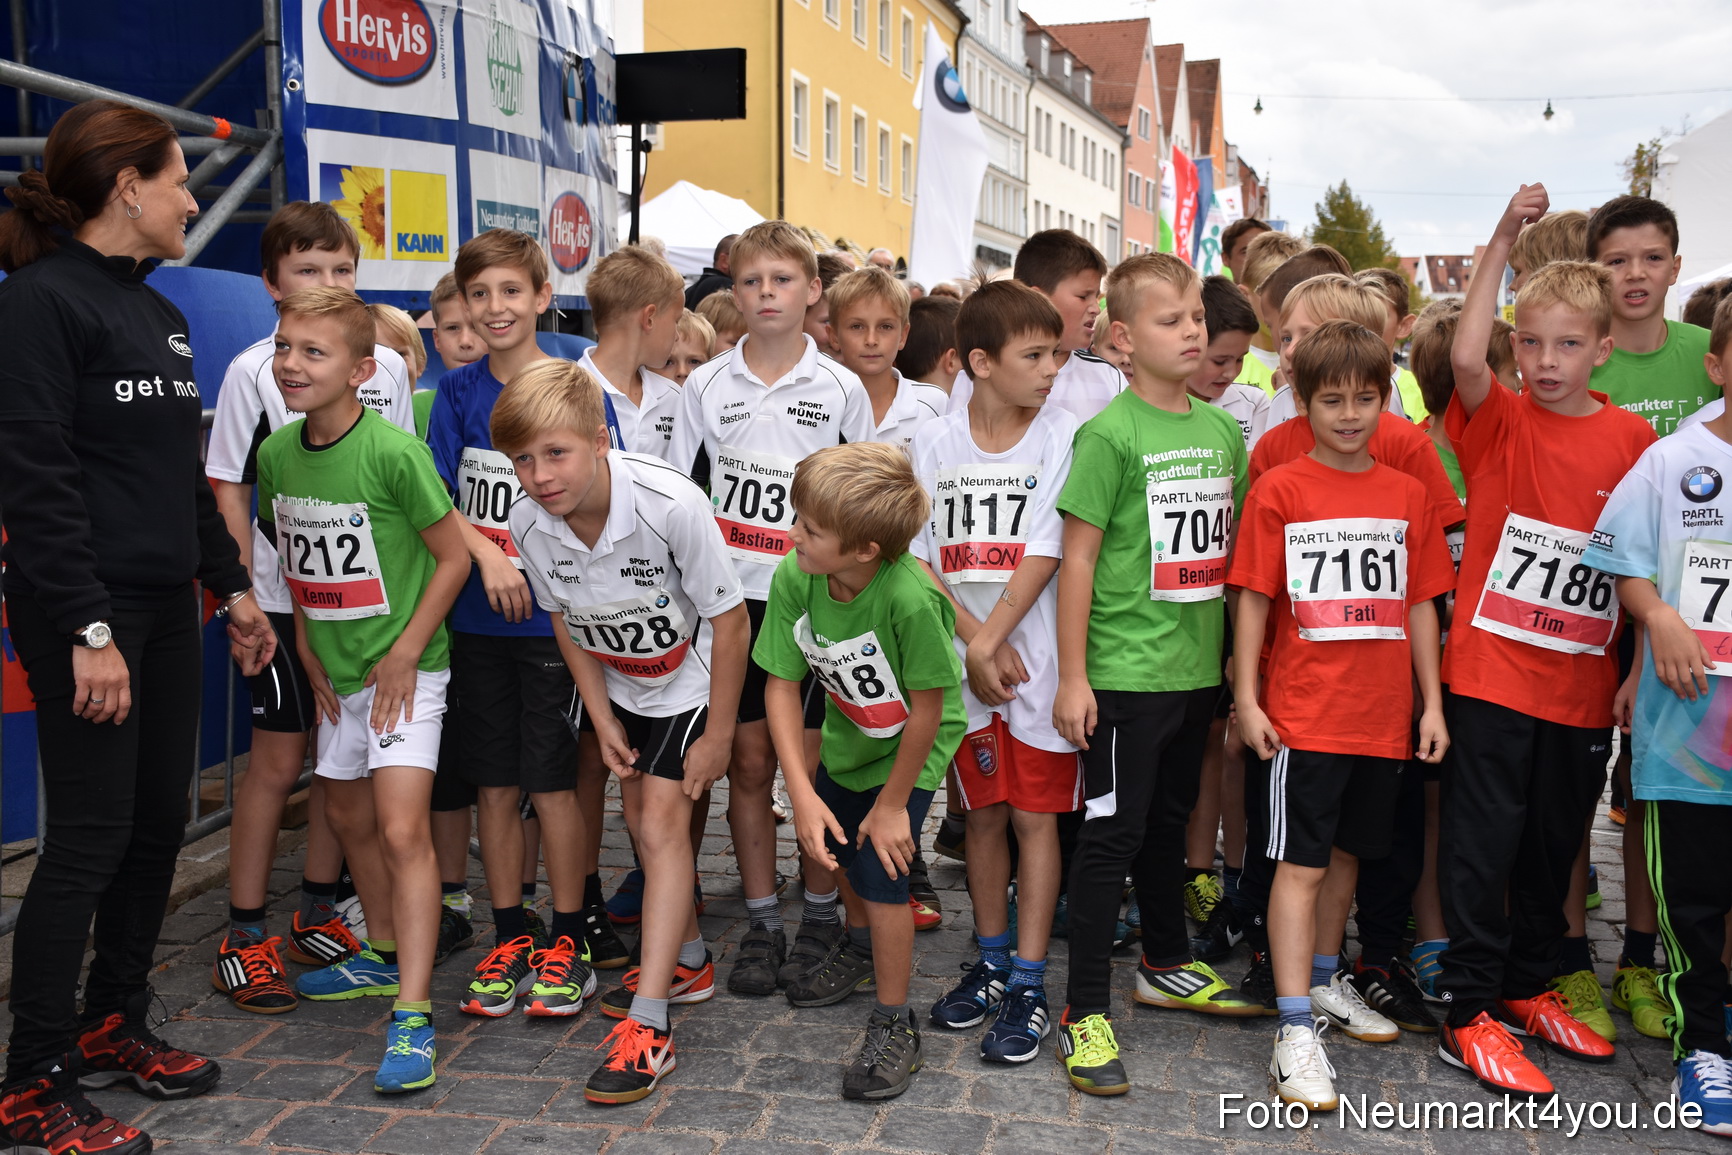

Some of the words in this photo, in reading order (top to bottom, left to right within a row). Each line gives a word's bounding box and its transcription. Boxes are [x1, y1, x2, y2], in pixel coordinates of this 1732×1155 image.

[336, 0, 428, 61] Hervis
[345, 46, 388, 63] SPORTS
[491, 64, 524, 115] SCHAU
[481, 208, 516, 228] Neumarkter
[552, 208, 590, 254] Hervis
[397, 233, 444, 254] KANN
[115, 376, 164, 402] get
[357, 396, 392, 406] MÜNCH
[798, 400, 823, 410] SPORT
[720, 412, 750, 425] Bastian
[787, 407, 830, 422] MÜNCH
[796, 418, 818, 428] BERG
[655, 423, 673, 432] MÜN
[1142, 446, 1213, 466] Neumarkter
[460, 458, 480, 472] PARTL
[482, 462, 516, 476] Neuma
[718, 456, 747, 472] PARTL
[750, 463, 794, 479] Neumar
[1146, 463, 1202, 484] Stadtlauf
[1684, 467, 1718, 480] BMW
[960, 476, 1020, 487] Neumarkt
[466, 477, 523, 522] 700
[723, 474, 797, 526] 703
[1151, 492, 1192, 505] PARTL
[1682, 508, 1724, 520] PARTL
[294, 518, 345, 528] Neumarkt
[1683, 519, 1723, 528] Neumarkt
[730, 527, 784, 551] Bastian
[1289, 532, 1334, 545] PARTL
[1338, 531, 1391, 542] Neumarkt
[1506, 525, 1549, 548] PARTL
[1590, 531, 1613, 546] CK
[281, 530, 366, 576] 7212
[629, 558, 650, 566] SPORT
[1302, 548, 1396, 593] 7161
[547, 570, 581, 584] Vincent
[620, 566, 664, 578] MÜNCH
[1506, 546, 1614, 611] 7186
[302, 587, 342, 608] Kenny
[1700, 577, 1732, 623] 7
[590, 606, 652, 622] Neumarkt
[1344, 605, 1375, 622] Fati
[1534, 610, 1564, 633] Tim
[568, 615, 678, 653] 7028
[608, 660, 669, 675] Vincent
